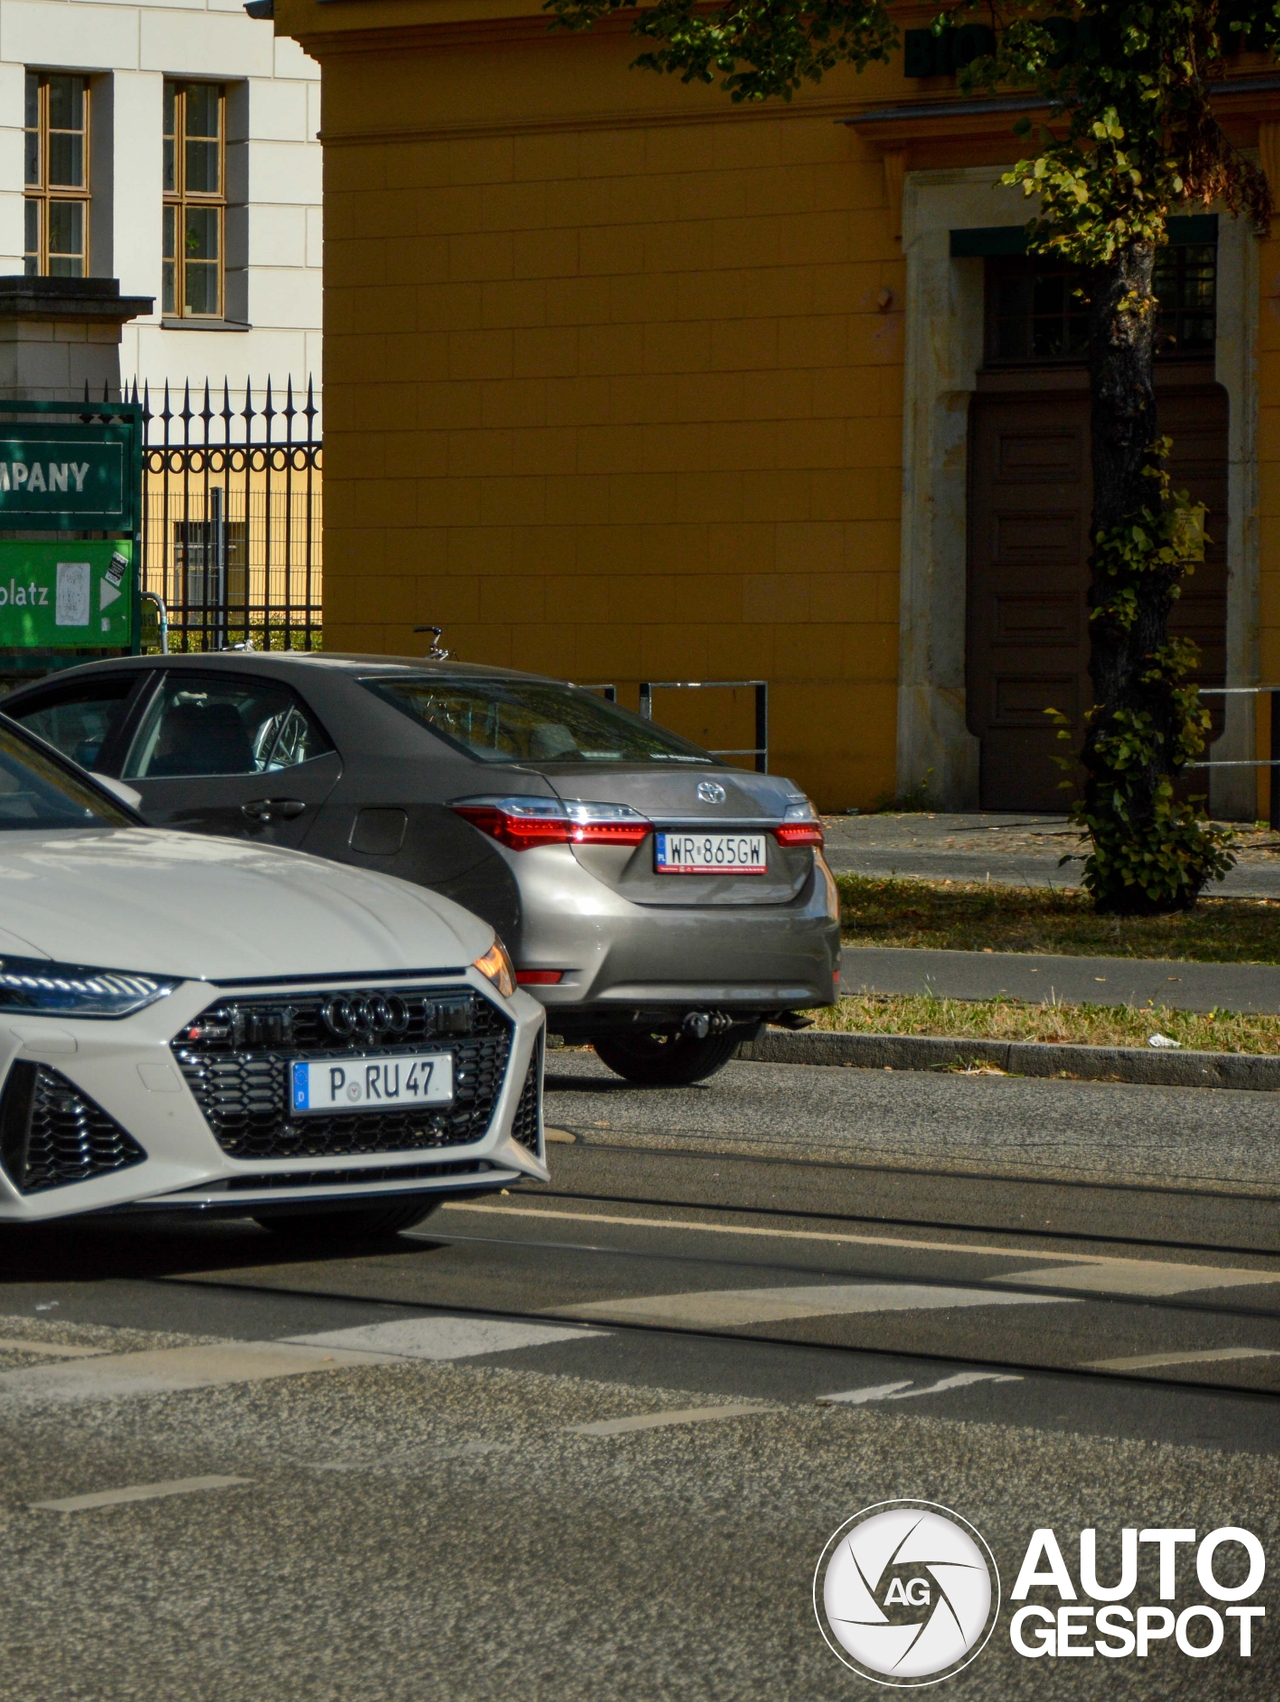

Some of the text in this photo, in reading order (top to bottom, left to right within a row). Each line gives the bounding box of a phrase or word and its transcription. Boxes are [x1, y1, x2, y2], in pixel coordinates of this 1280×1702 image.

[670, 838, 761, 864] WR 865GW
[329, 1066, 346, 1101] P
[297, 1091, 305, 1103] D
